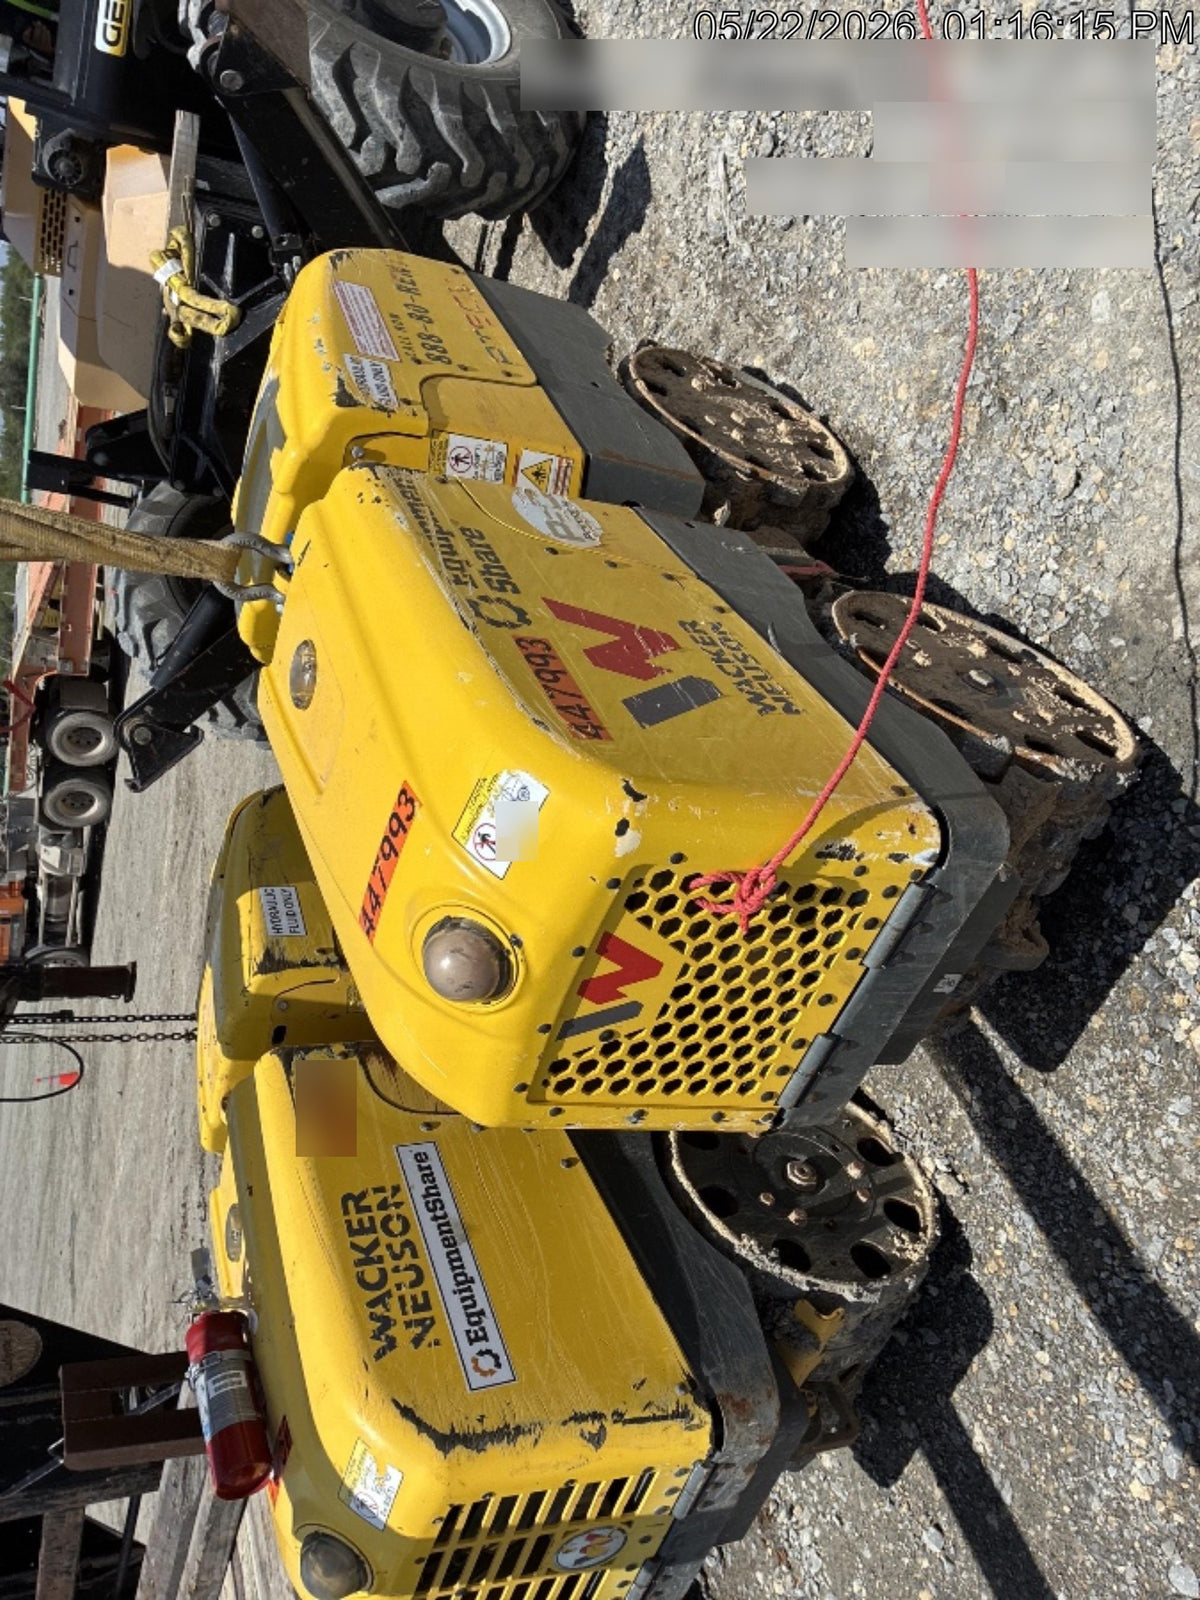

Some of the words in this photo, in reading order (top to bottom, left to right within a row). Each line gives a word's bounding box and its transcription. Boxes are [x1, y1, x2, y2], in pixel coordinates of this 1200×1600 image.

[458, 526, 522, 595] Share
[513, 637, 604, 740] 447993
[677, 619, 778, 716] WACKER
[708, 621, 803, 716] NEUSON
[264, 888, 284, 934] HYDRAULIC
[281, 888, 295, 909] ONLY
[360, 787, 417, 939] 447993
[340, 1188, 399, 1363] WACKER
[372, 1183, 442, 1349] NEUSON
[410, 1150, 491, 1346] EquipmentShare
